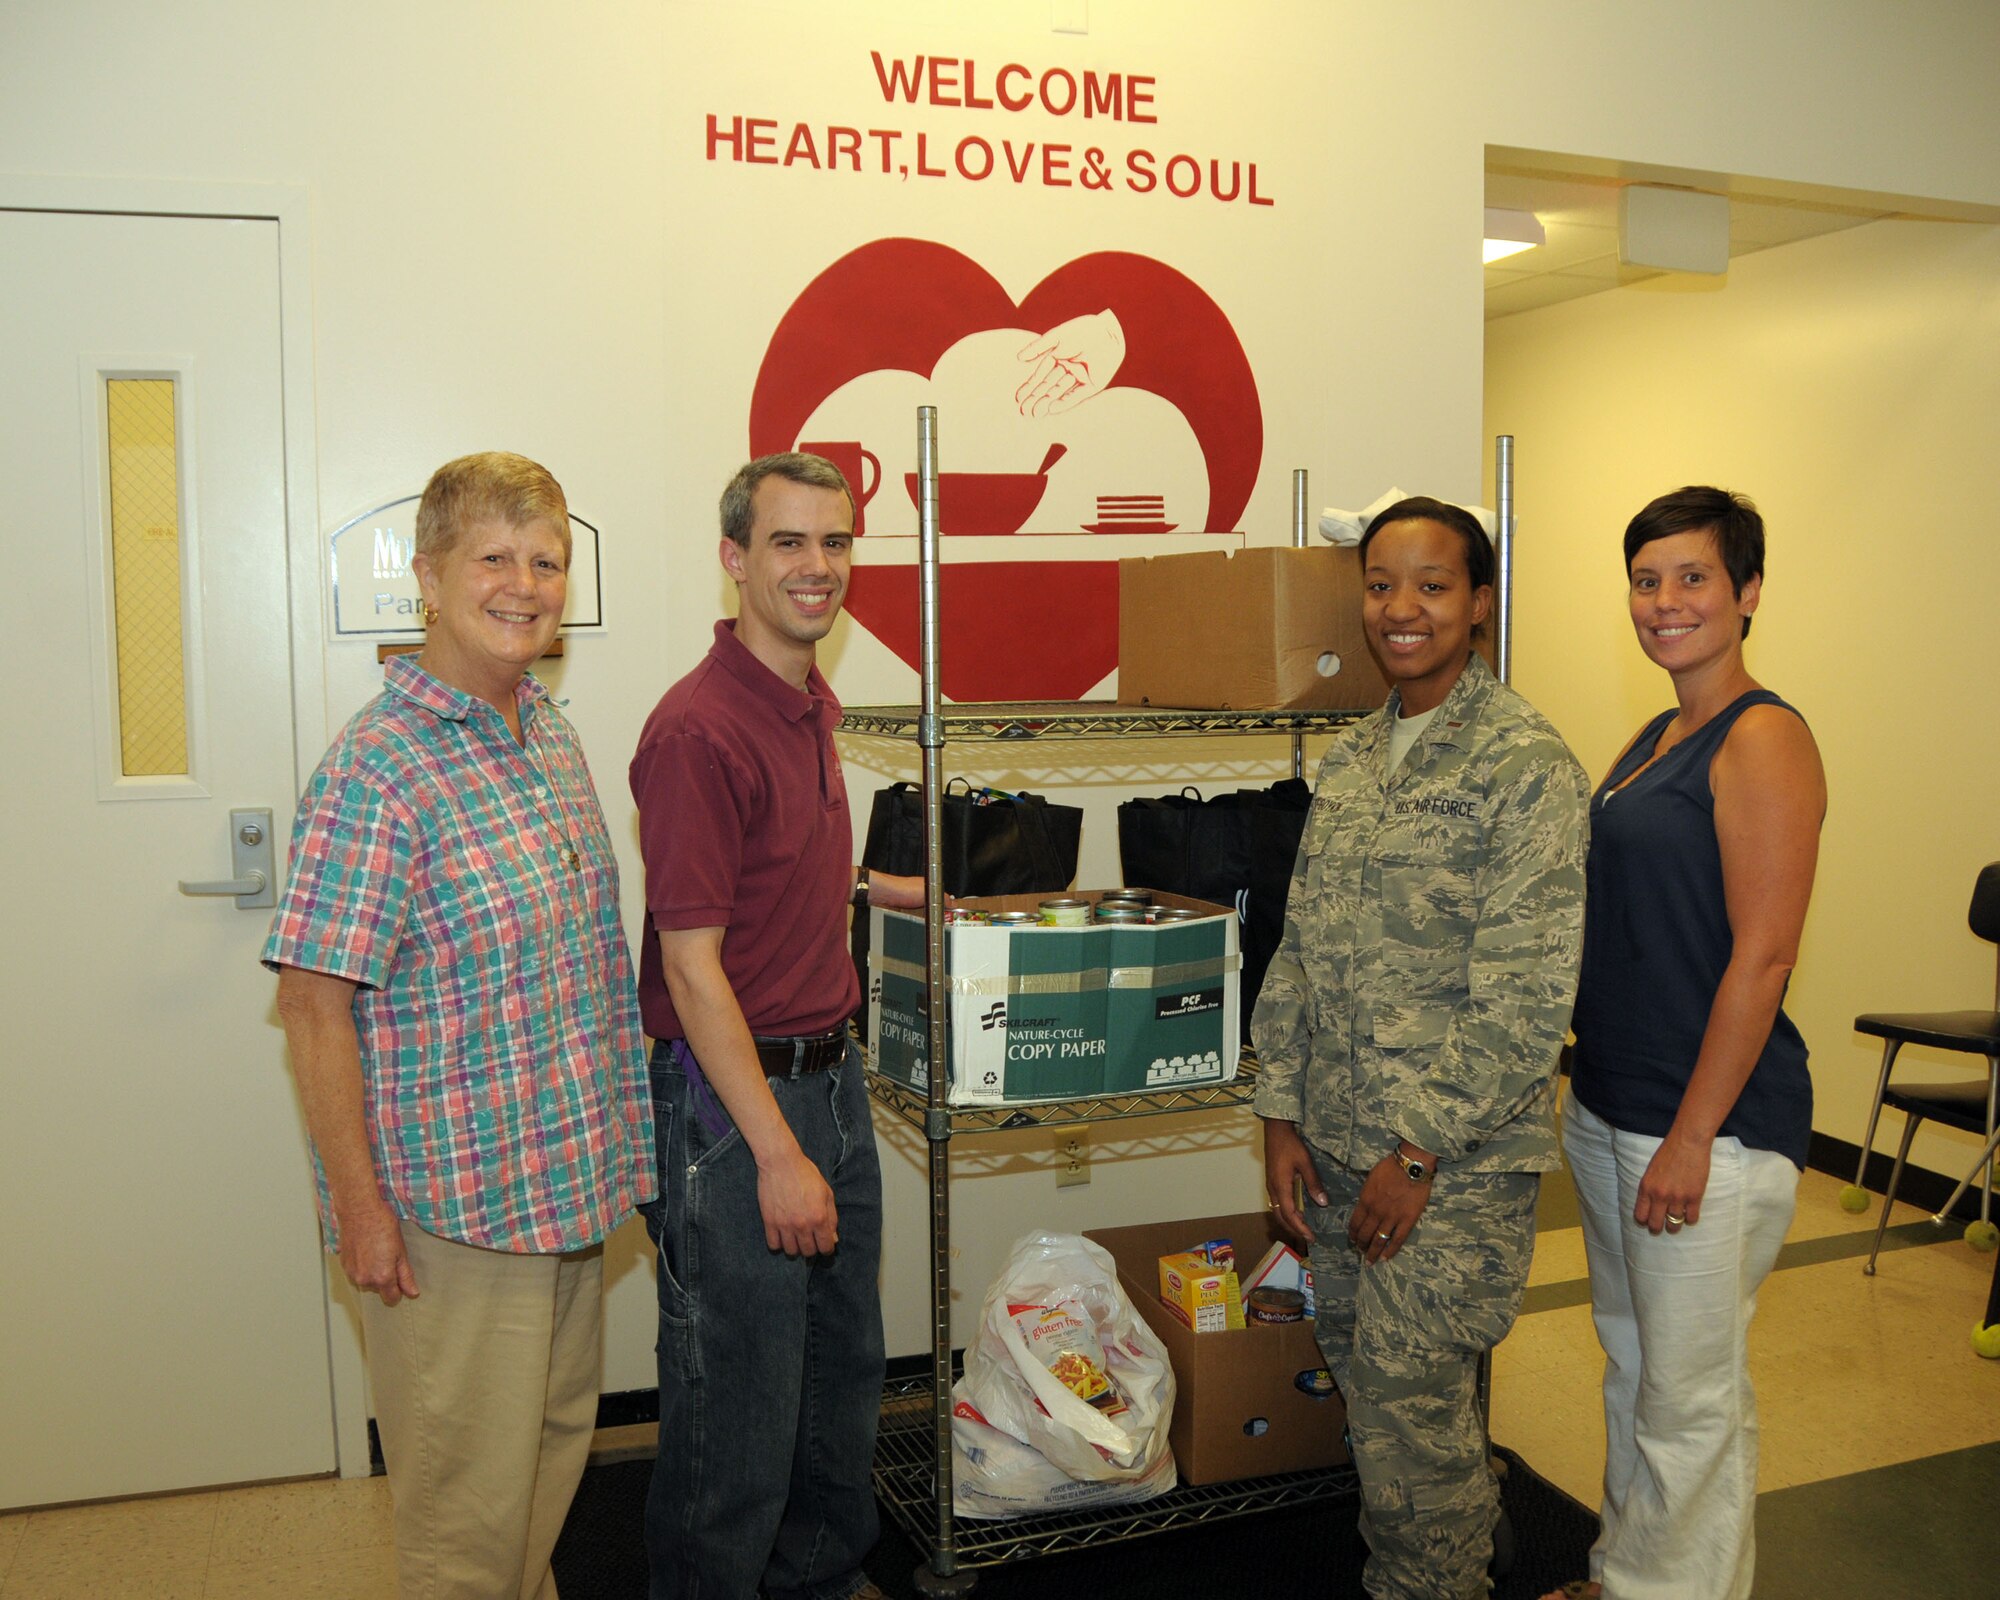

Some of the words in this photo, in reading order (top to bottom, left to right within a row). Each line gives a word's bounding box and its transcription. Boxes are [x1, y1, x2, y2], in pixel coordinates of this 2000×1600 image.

[870, 50, 1157, 124] WELCOME
[1411, 799, 1430, 814] AIR
[1432, 799, 1477, 818] FORCE
[1181, 994, 1201, 1007] PCF
[998, 1018, 1057, 1028] SKILCRAFT
[880, 1020, 901, 1040] COPY
[902, 1028, 925, 1050] PAPER
[1008, 1028, 1084, 1040] NATURE-CYCLE
[1008, 1043, 1055, 1060] COPY
[1060, 1039, 1106, 1058] PAPER
[1032, 1320, 1064, 1341] gluten
